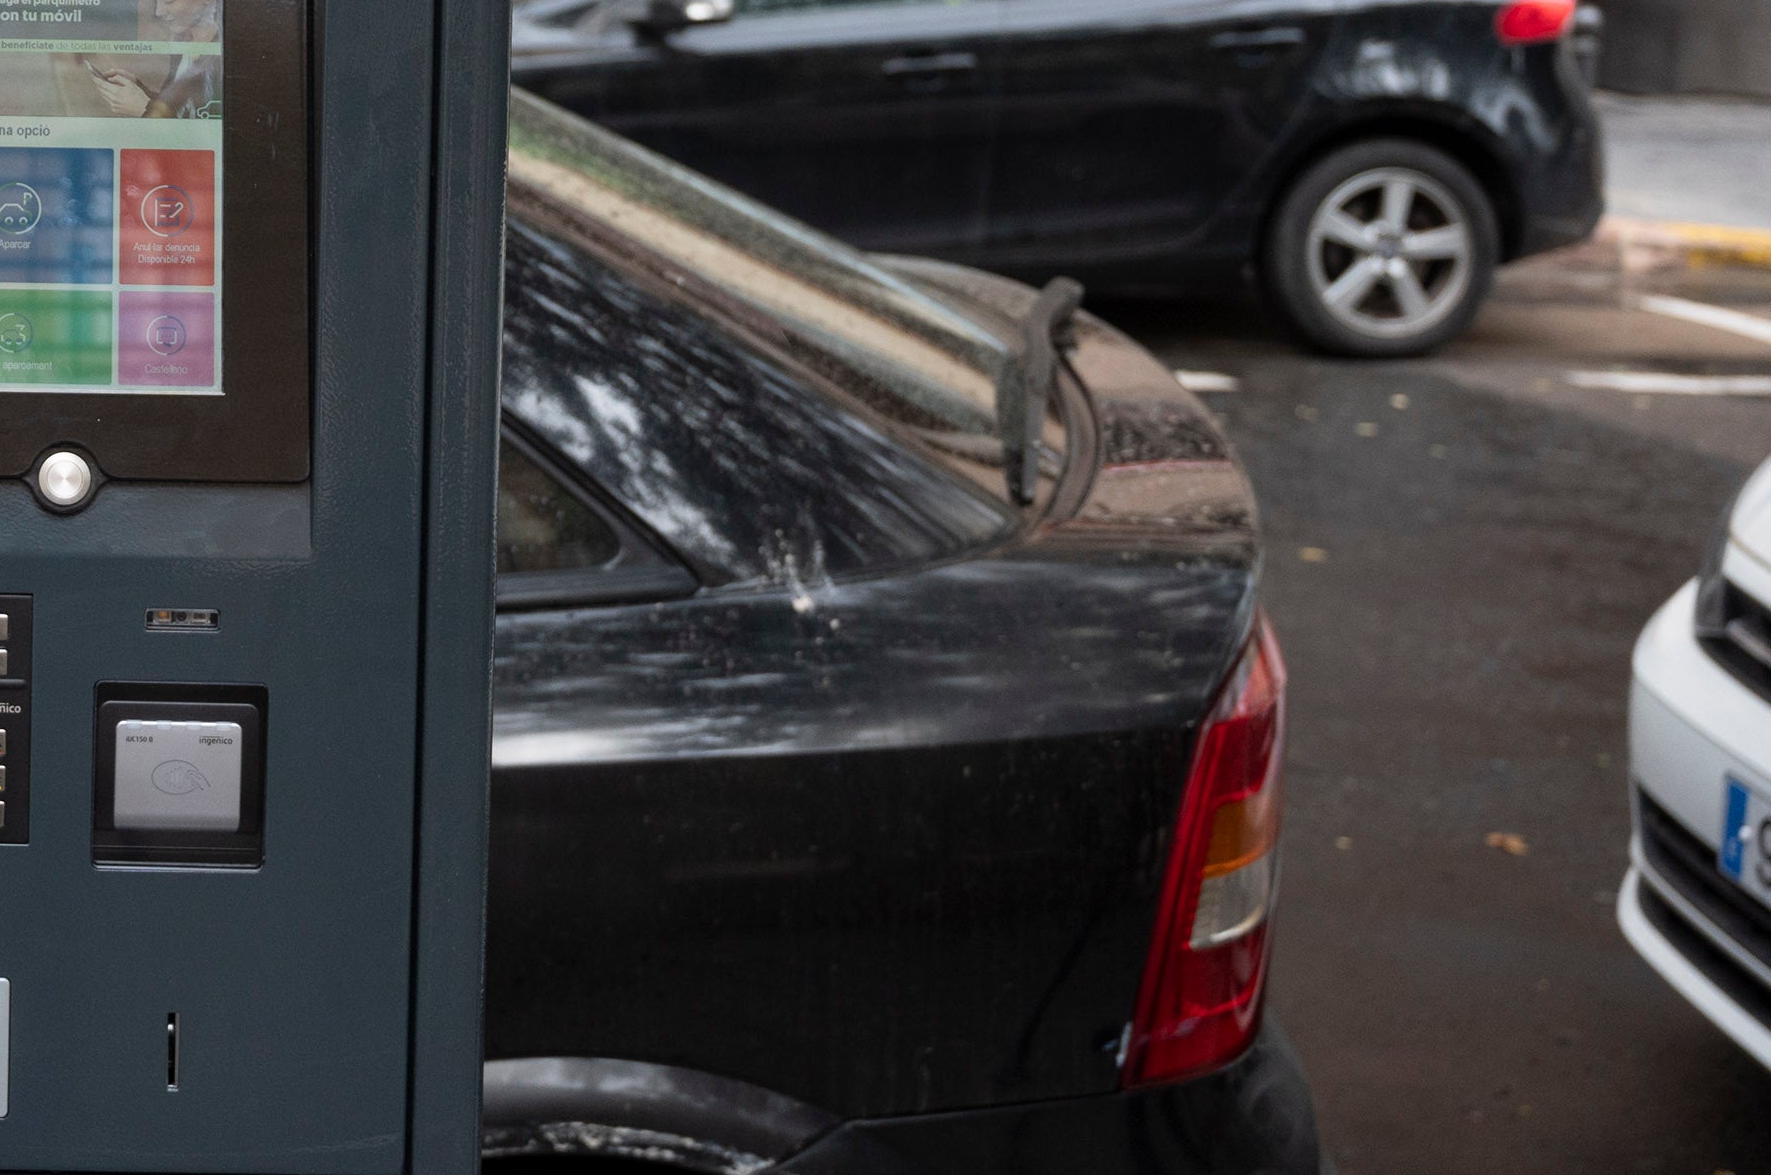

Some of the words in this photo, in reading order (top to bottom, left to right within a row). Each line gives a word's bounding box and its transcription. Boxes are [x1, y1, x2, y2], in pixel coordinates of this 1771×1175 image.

[22, 10, 38, 22] tu
[40, 9, 82, 23] móvil
[113, 43, 153, 53] ventajas
[16, 125, 51, 140] opció
[138, 255, 178, 264] Disponible
[180, 255, 195, 264] 24h
[198, 735, 233, 746] ingenico
